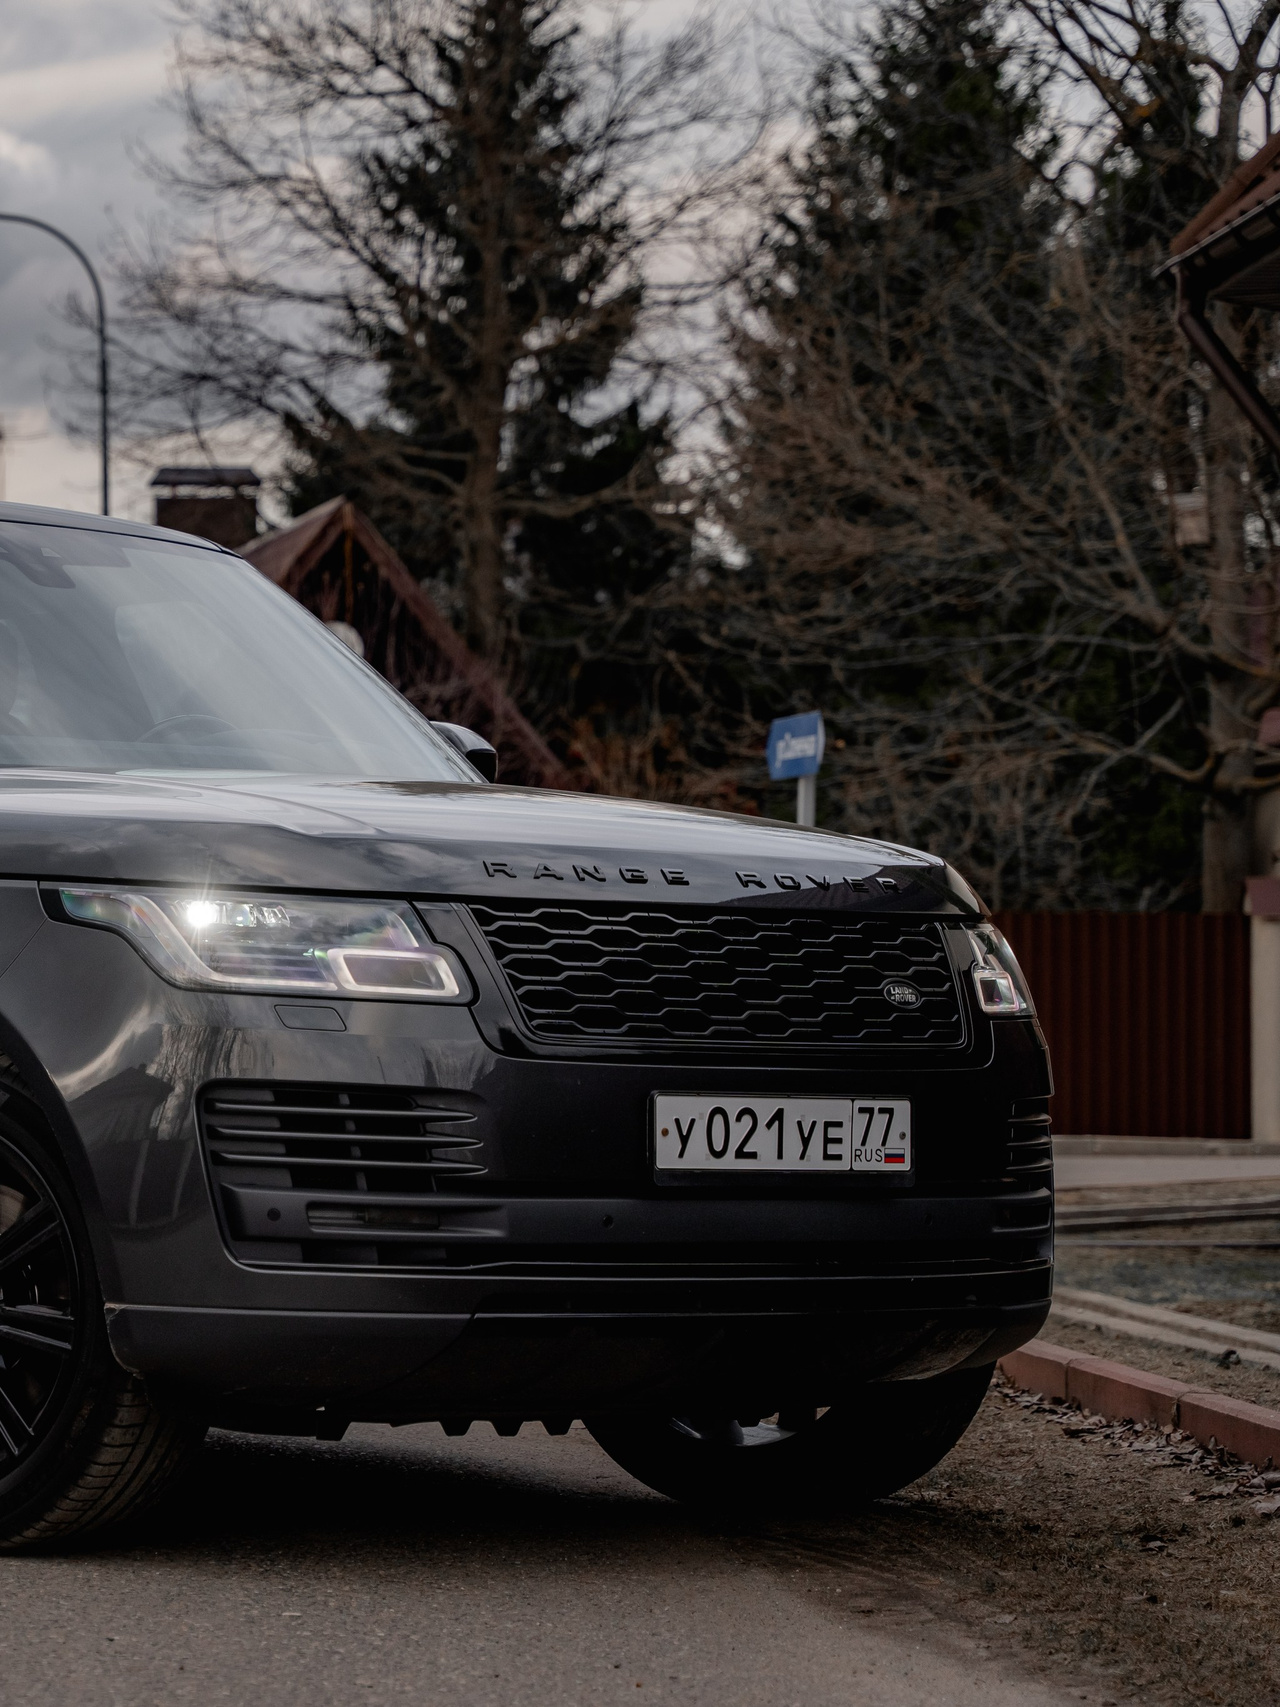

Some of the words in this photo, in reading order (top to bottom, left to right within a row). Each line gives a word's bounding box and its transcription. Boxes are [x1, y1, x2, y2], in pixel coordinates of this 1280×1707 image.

[482, 859, 690, 886] RANGE
[735, 870, 903, 894] ROVER
[890, 986, 909, 994] LAND
[895, 994, 916, 1002] ROVER
[857, 1106, 895, 1148] 77
[854, 1148, 883, 1163] RUS
